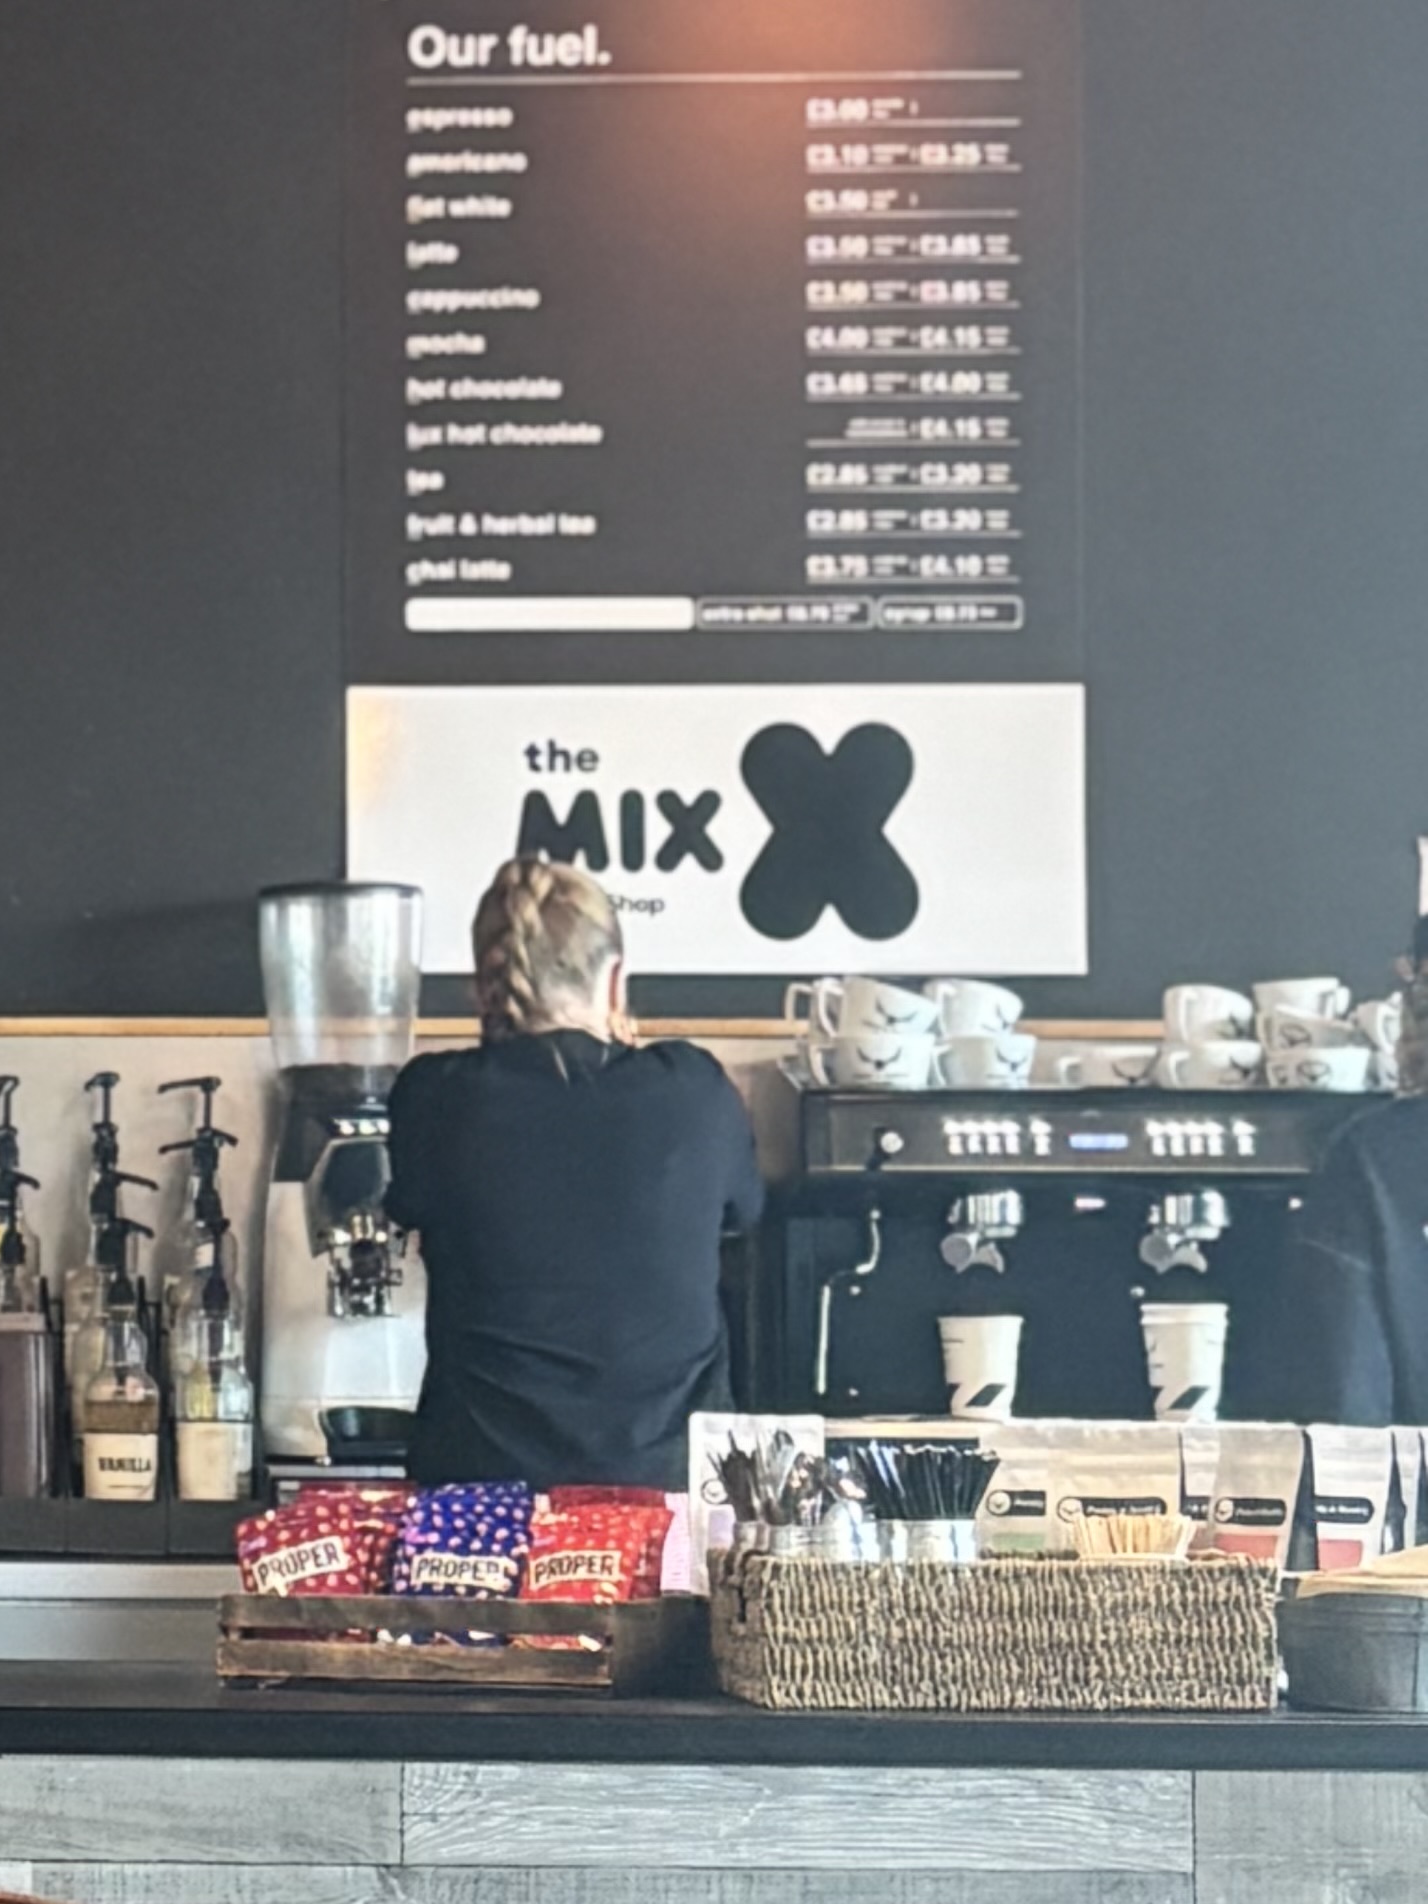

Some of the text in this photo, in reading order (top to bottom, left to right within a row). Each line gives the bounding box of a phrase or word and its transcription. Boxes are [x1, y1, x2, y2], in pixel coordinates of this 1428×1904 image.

[407, 24, 612, 68] Our fuel.
[523, 740, 601, 774] the
[516, 789, 725, 873] MIX
[98, 1457, 152, 1475] VANILLA
[256, 1541, 342, 1586] PROPER
[533, 1555, 615, 1584] PROPER
